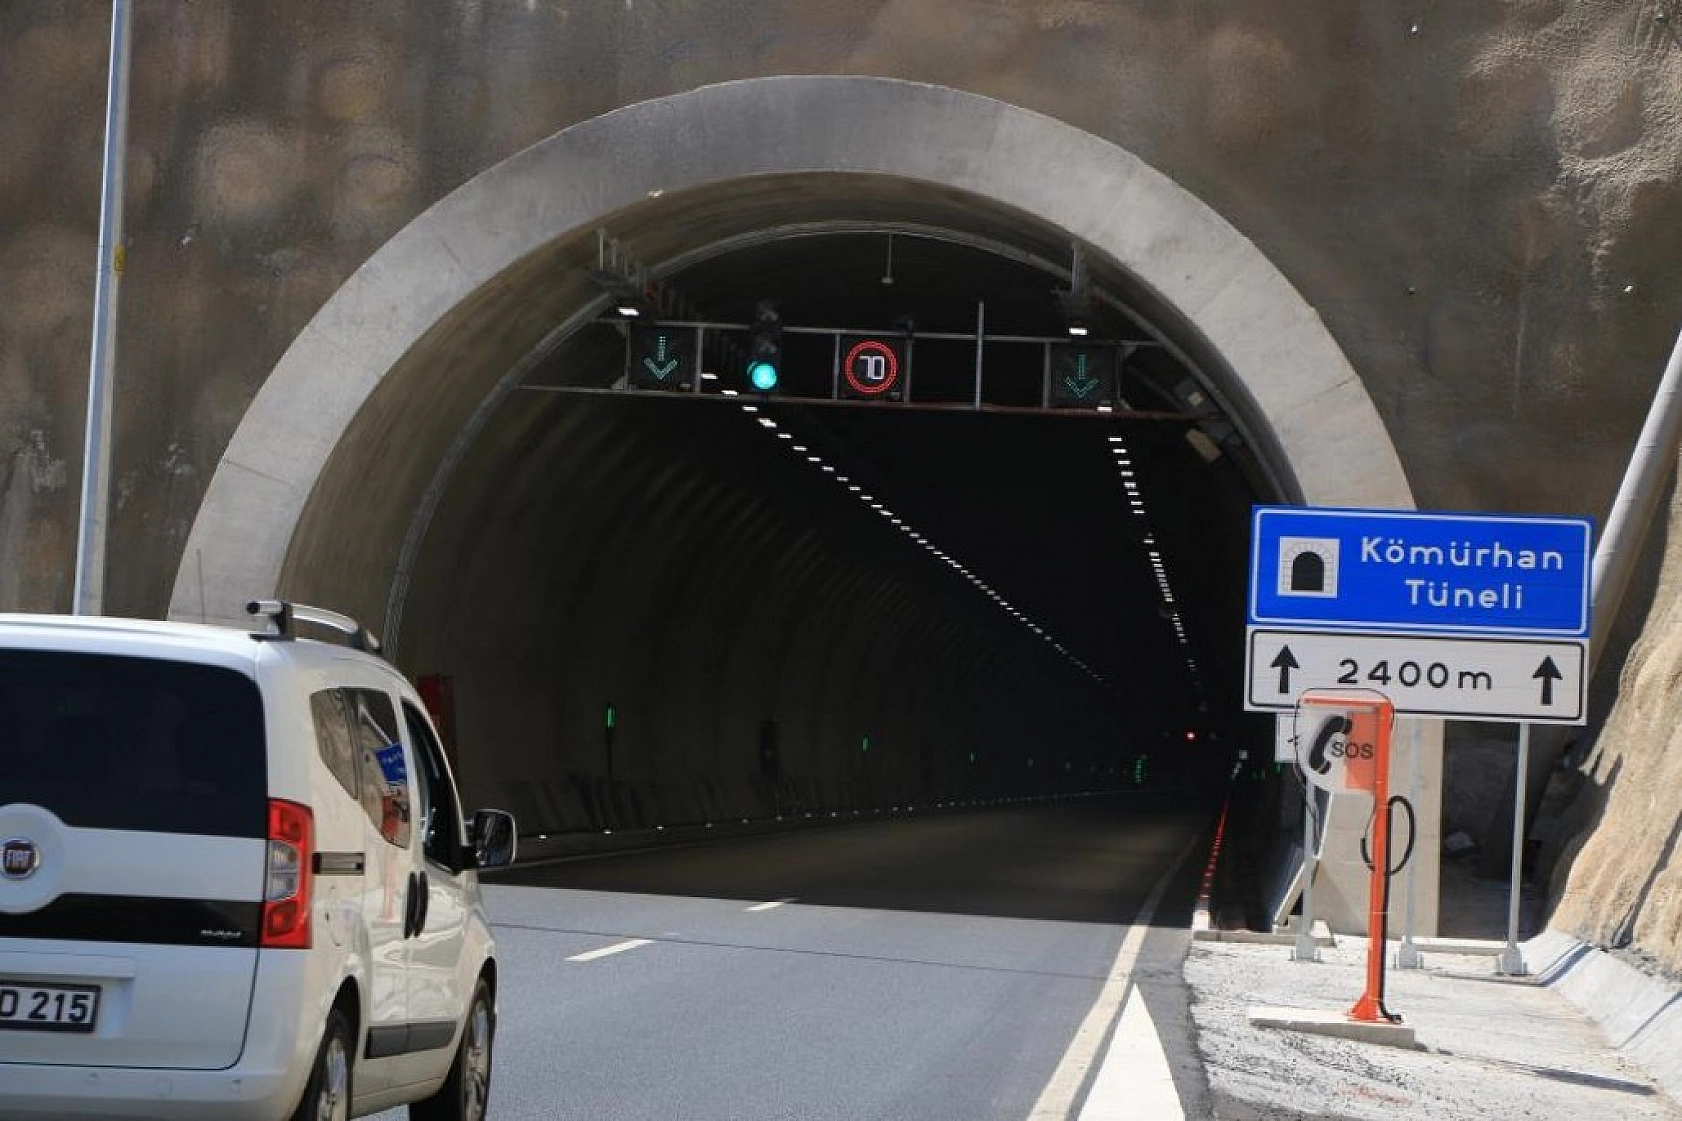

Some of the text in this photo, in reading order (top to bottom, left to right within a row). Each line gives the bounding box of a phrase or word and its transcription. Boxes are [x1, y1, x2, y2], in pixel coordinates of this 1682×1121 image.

[859, 355, 885, 380] 70
[1360, 536, 1564, 570] Kömürhan
[1404, 578, 1523, 610] Tüneli
[1331, 741, 1374, 759] SOS
[27, 991, 89, 1022] 215
